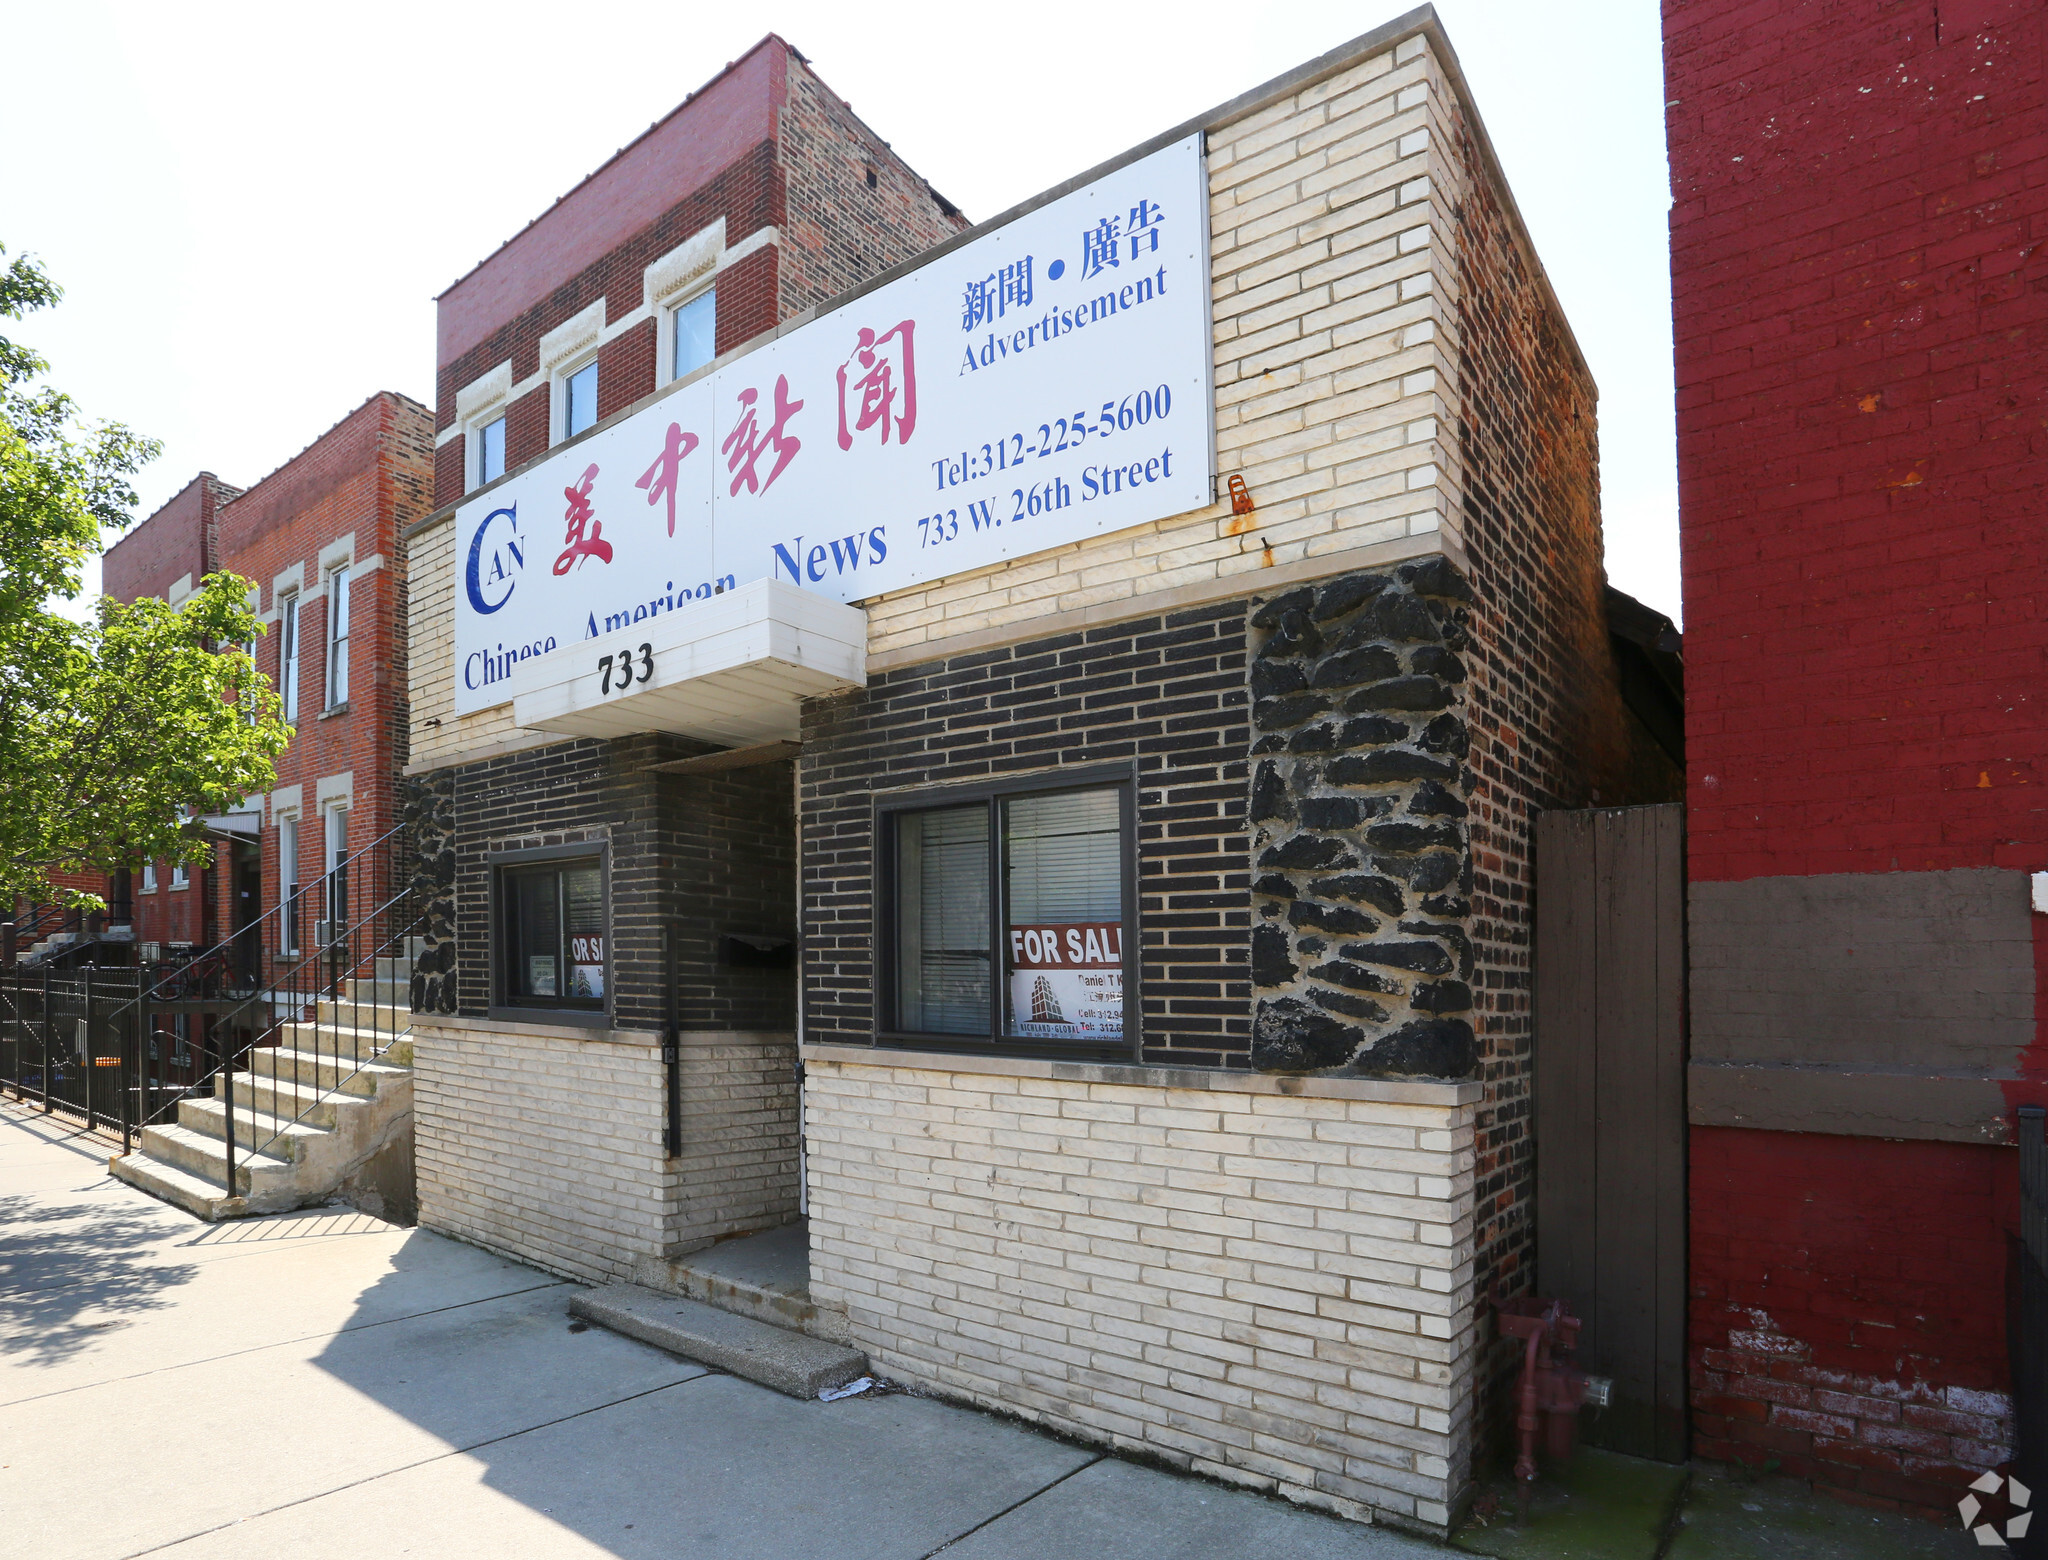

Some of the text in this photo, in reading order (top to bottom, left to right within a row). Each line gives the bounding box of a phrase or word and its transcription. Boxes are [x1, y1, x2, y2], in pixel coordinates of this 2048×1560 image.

[958, 264, 1168, 377] Advertisement
[931, 384, 1172, 491] Tel:312-225-5600
[917, 445, 1173, 549] 733 W. 26th Street
[770, 525, 888, 587] News
[598, 642, 654, 696] 733
[1010, 929, 1062, 964] FOR
